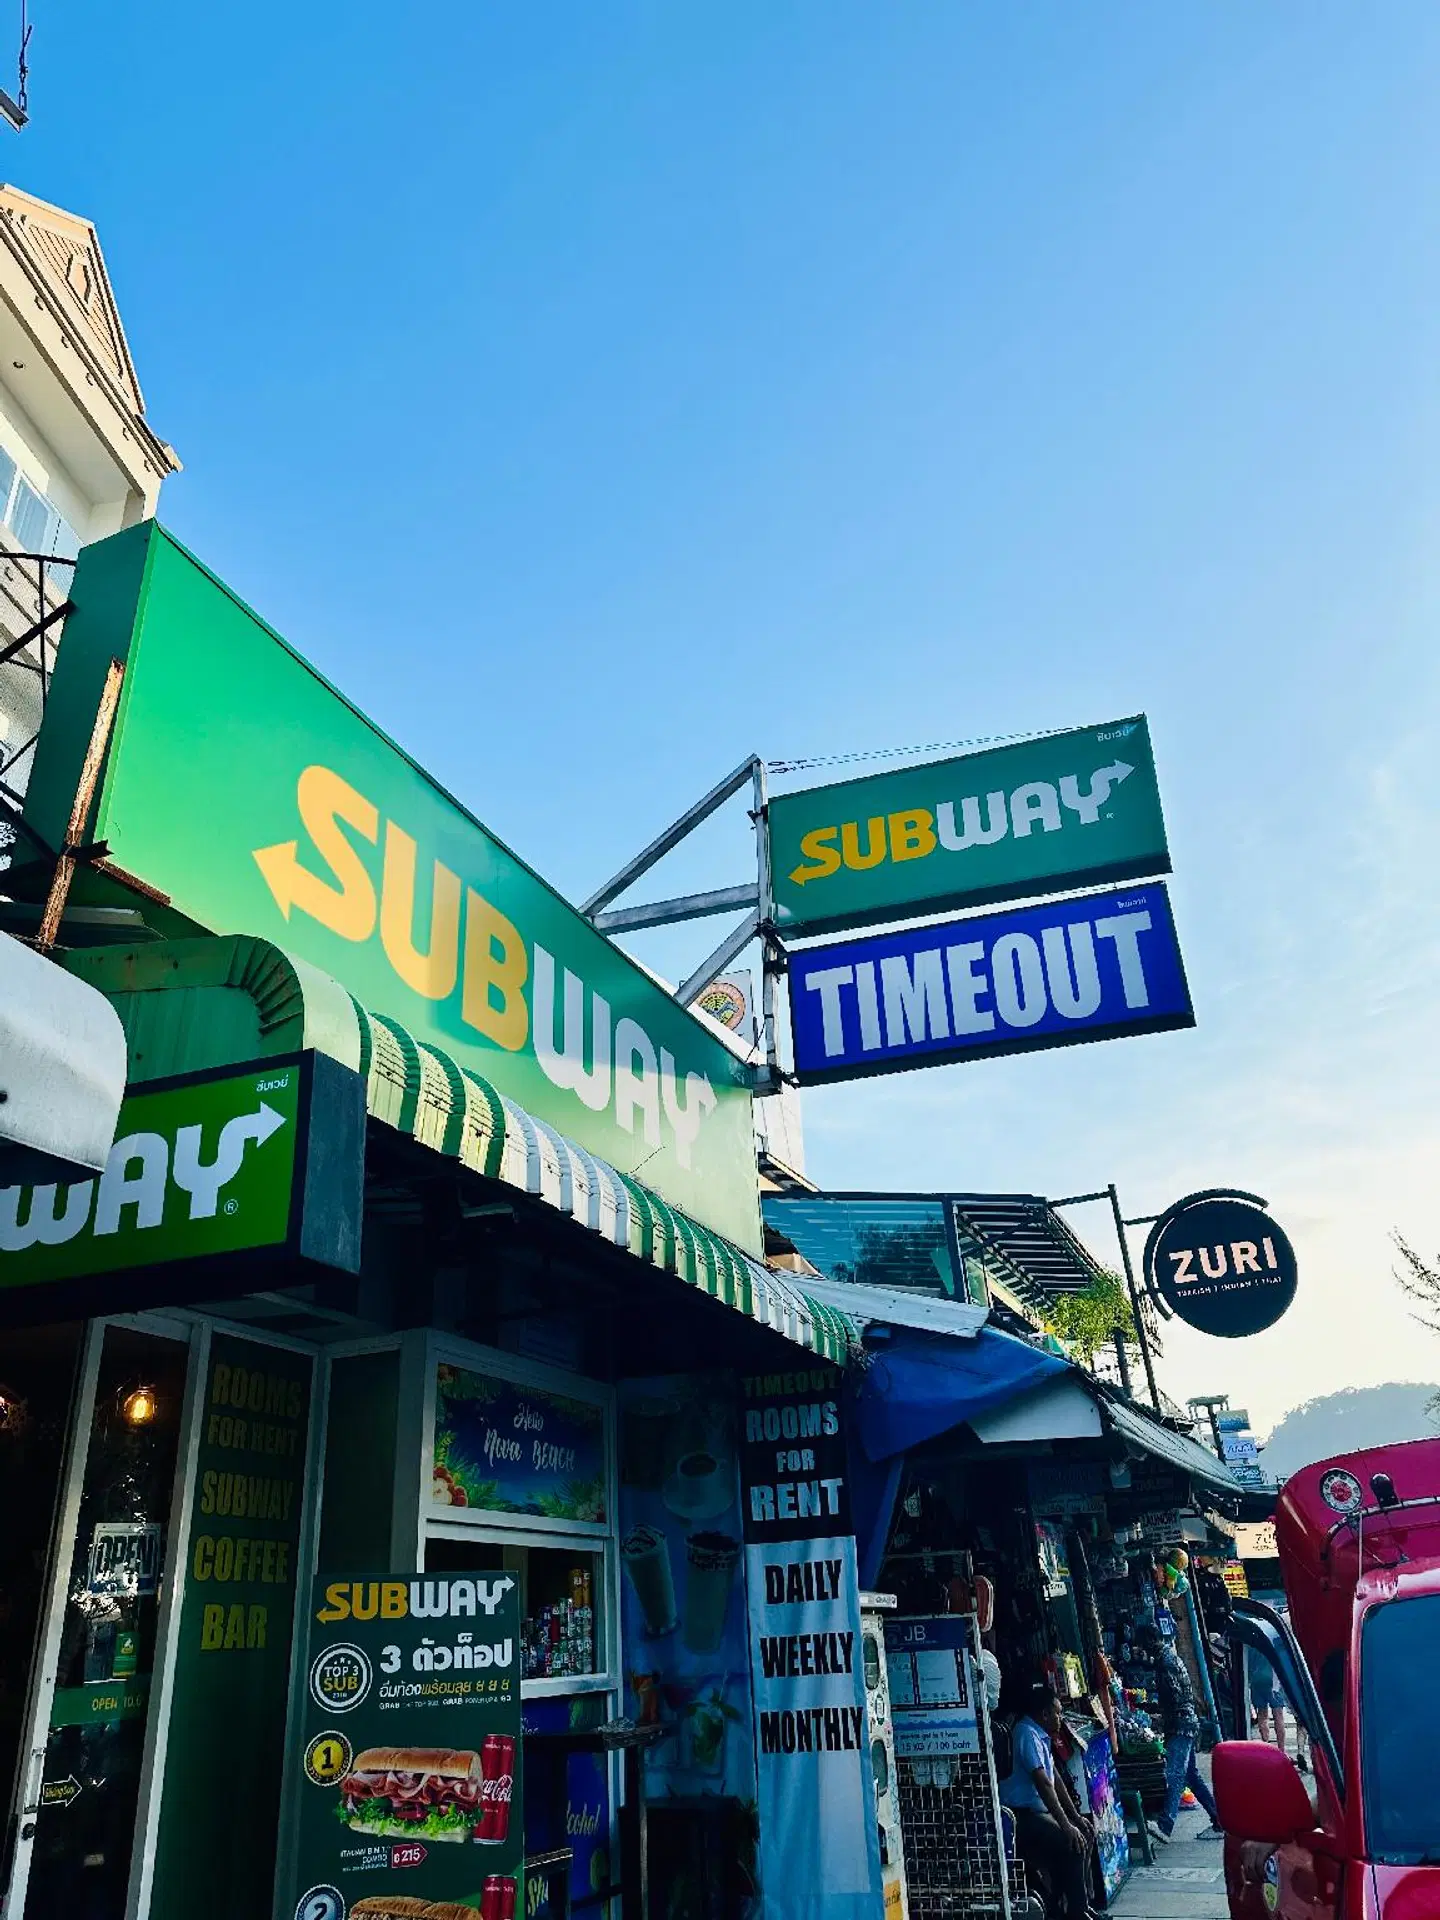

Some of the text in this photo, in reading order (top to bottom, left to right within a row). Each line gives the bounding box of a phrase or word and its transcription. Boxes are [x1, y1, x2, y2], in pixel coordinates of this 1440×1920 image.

[789, 760, 1137, 886] SUBWAY
[252, 765, 717, 1171] SUBWAY
[805, 910, 1153, 1058] TIMEOUT
[1169, 1237, 1278, 1284] ZURI
[212, 1363, 301, 1419] ROOMS
[741, 1368, 839, 1399] TIMEOUT
[207, 1414, 298, 1457] FOR RENT
[745, 1401, 840, 1443] ROOMS
[776, 1449, 817, 1474] FOR
[200, 1469, 295, 1521] SUBWAY
[750, 1478, 844, 1522] RENT
[193, 1535, 290, 1584] COFFEE
[765, 1559, 843, 1605] DAILY
[316, 1576, 515, 1624] SUBWAY
[201, 1603, 268, 1650] BAR
[903, 1624, 926, 1642] JB
[324, 1665, 359, 1677] TOP 3
[380, 1644, 401, 1673] 3
[760, 1632, 854, 1679] WEEKLY
[92, 1696, 118, 1711] OPEN
[324, 1676, 358, 1691] SUB
[760, 1707, 864, 1754] MONTHLY
[322, 1747, 334, 1769] 1
[313, 1902, 328, 1920] 2
